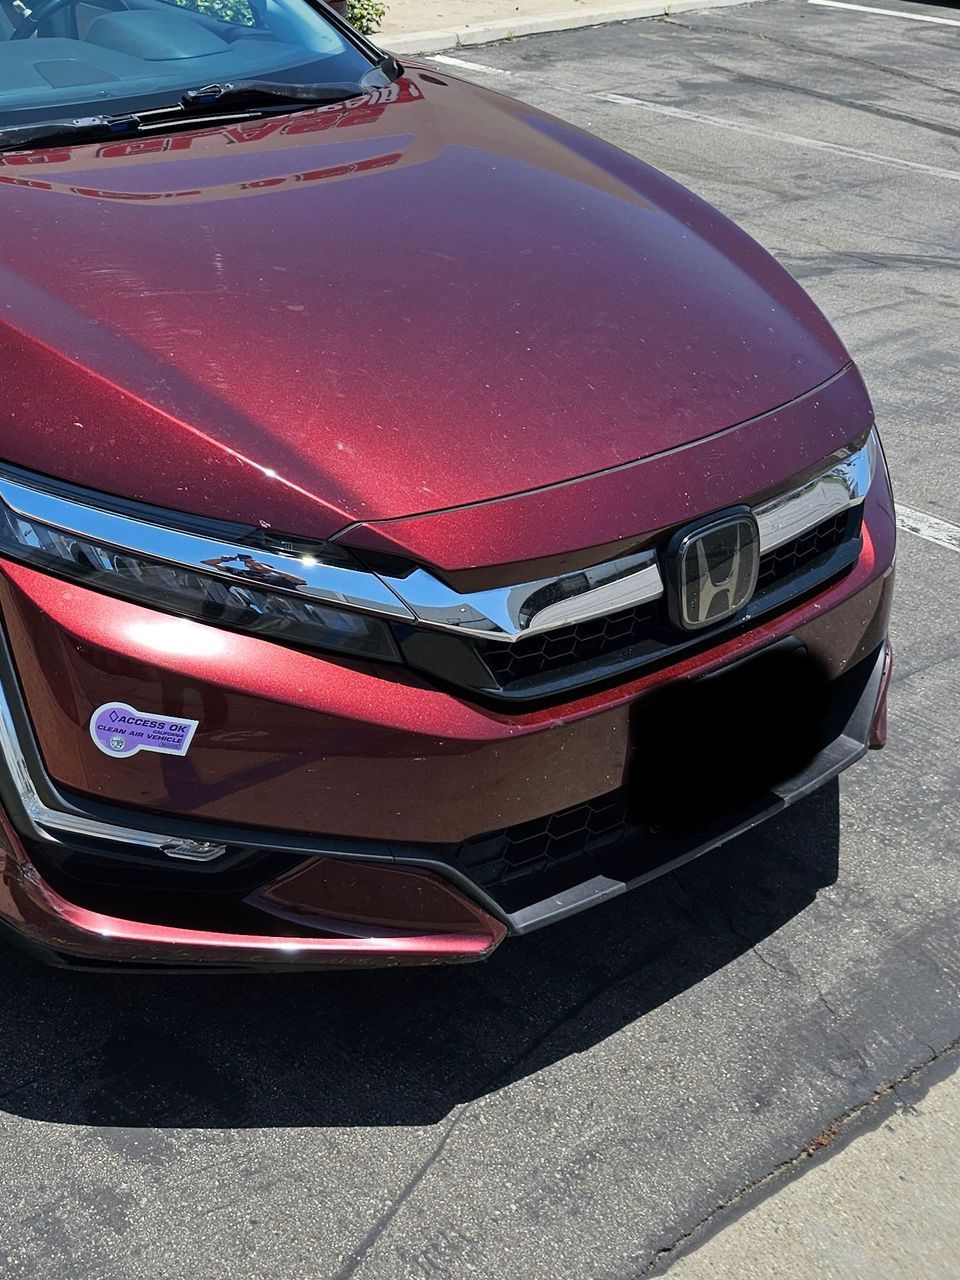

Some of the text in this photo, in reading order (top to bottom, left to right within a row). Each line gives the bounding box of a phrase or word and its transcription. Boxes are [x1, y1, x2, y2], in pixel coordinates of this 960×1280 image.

[117, 715, 188, 733] ACCESS OK
[97, 724, 182, 744] CLEAN AIR VEHICLE
[153, 729, 185, 738] CALIFORNIA
